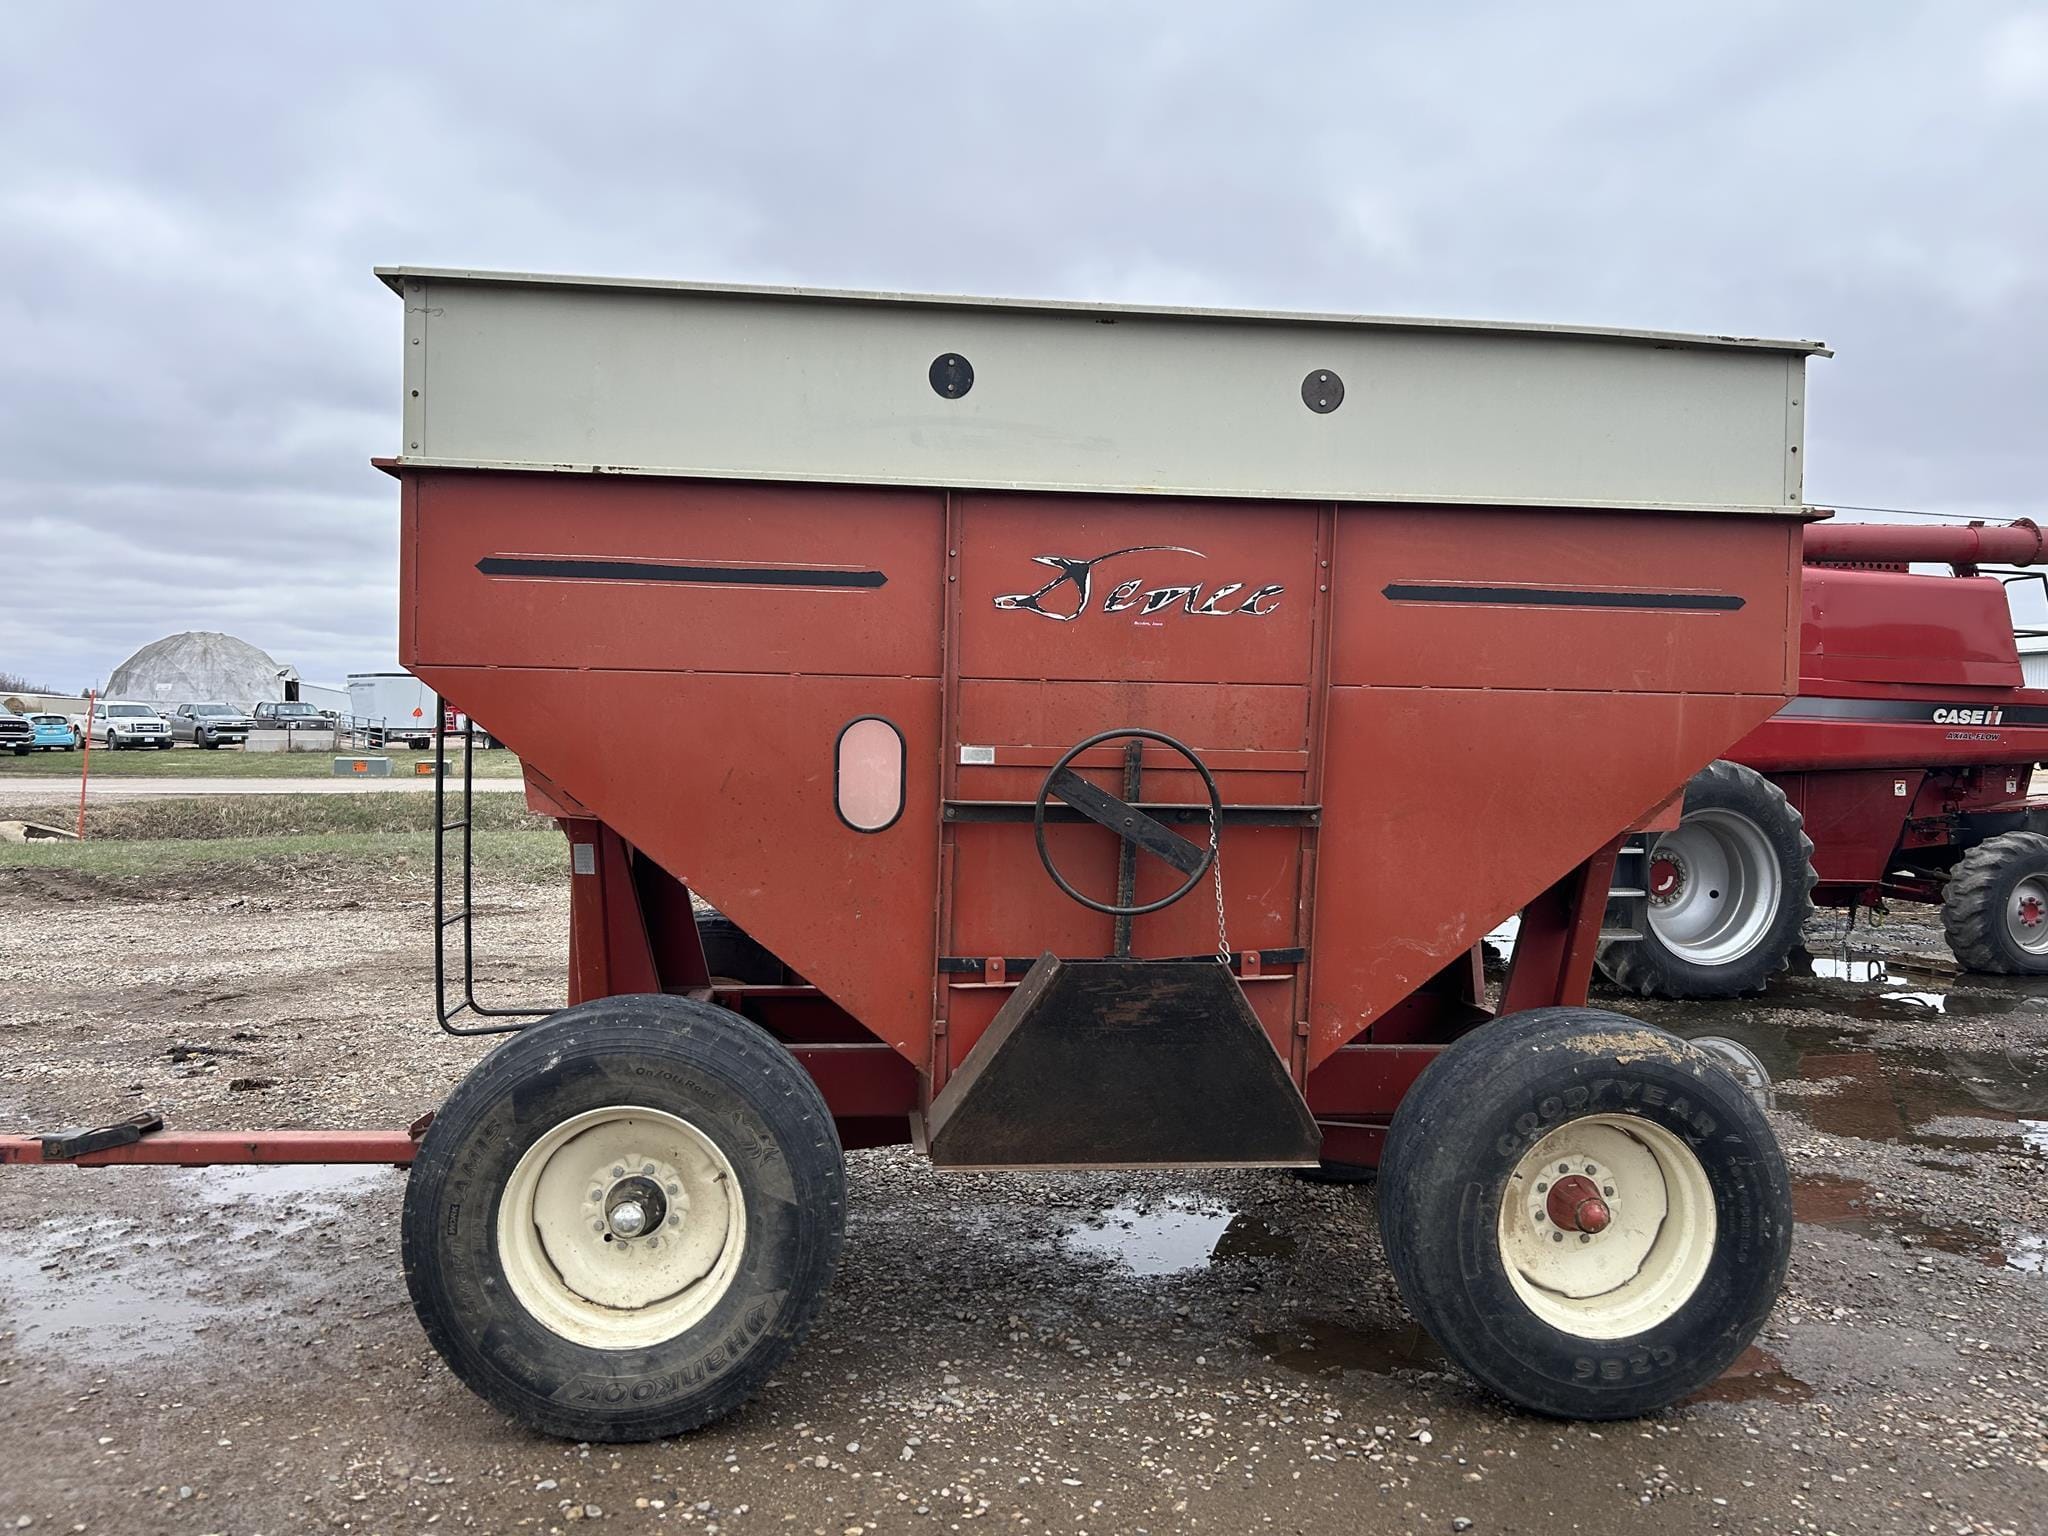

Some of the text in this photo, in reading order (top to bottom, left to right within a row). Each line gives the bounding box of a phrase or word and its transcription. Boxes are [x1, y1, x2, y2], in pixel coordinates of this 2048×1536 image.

[1932, 708, 1985, 725] CASE
[1499, 1078, 1717, 1157] GOODYEAR
[1573, 1344, 1679, 1380] G286
